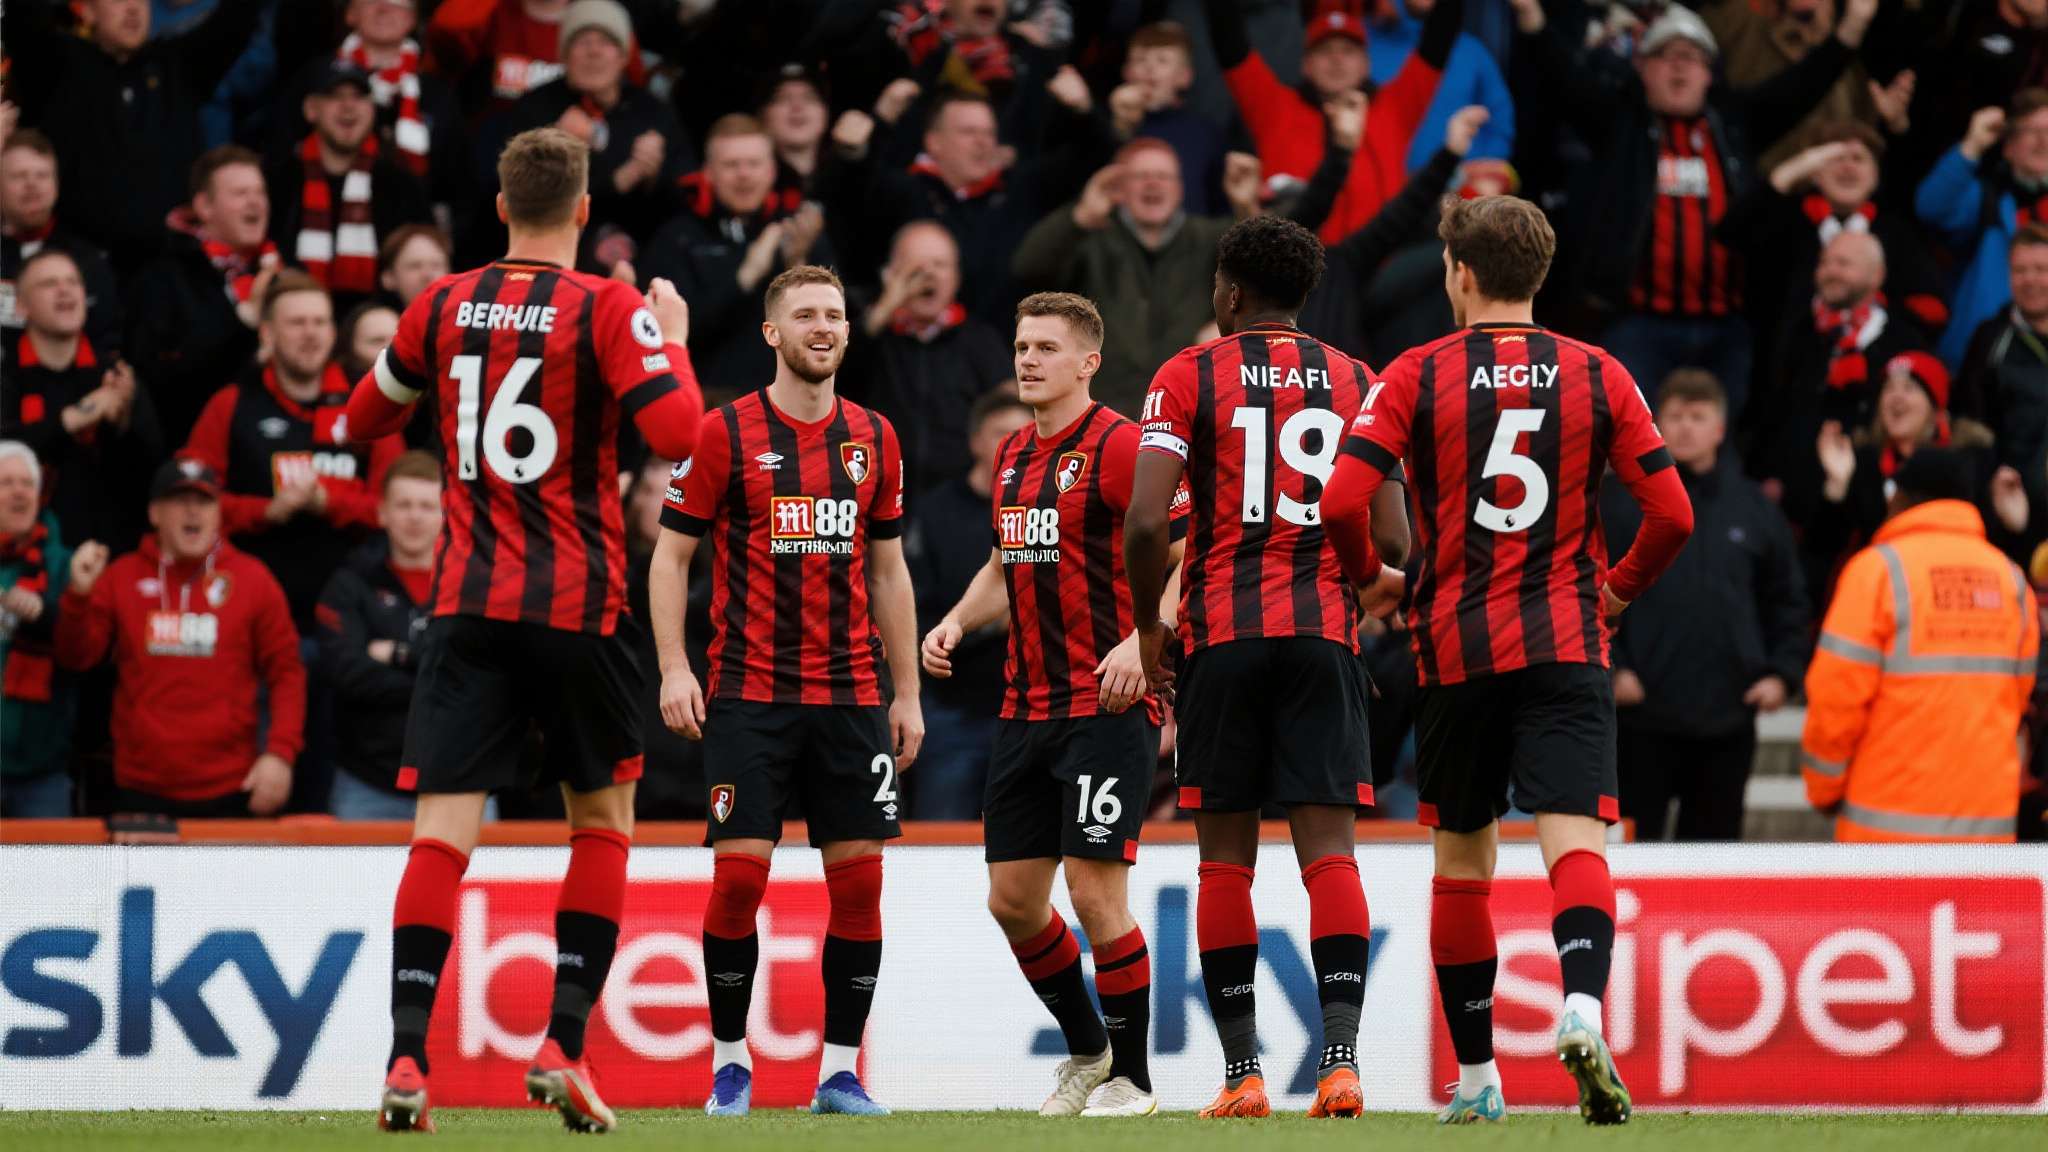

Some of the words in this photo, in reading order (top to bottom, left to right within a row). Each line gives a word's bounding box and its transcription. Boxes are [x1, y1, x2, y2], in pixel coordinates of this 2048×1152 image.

[449, 355, 558, 484] 16
[1231, 406, 1345, 526] 19
[1473, 408, 1549, 533] 5
[871, 753, 897, 802] 2
[1077, 774, 1122, 825] 16
[0, 886, 365, 1098] sky
[458, 888, 819, 1060] bet
[1492, 887, 2004, 1095] sipet
